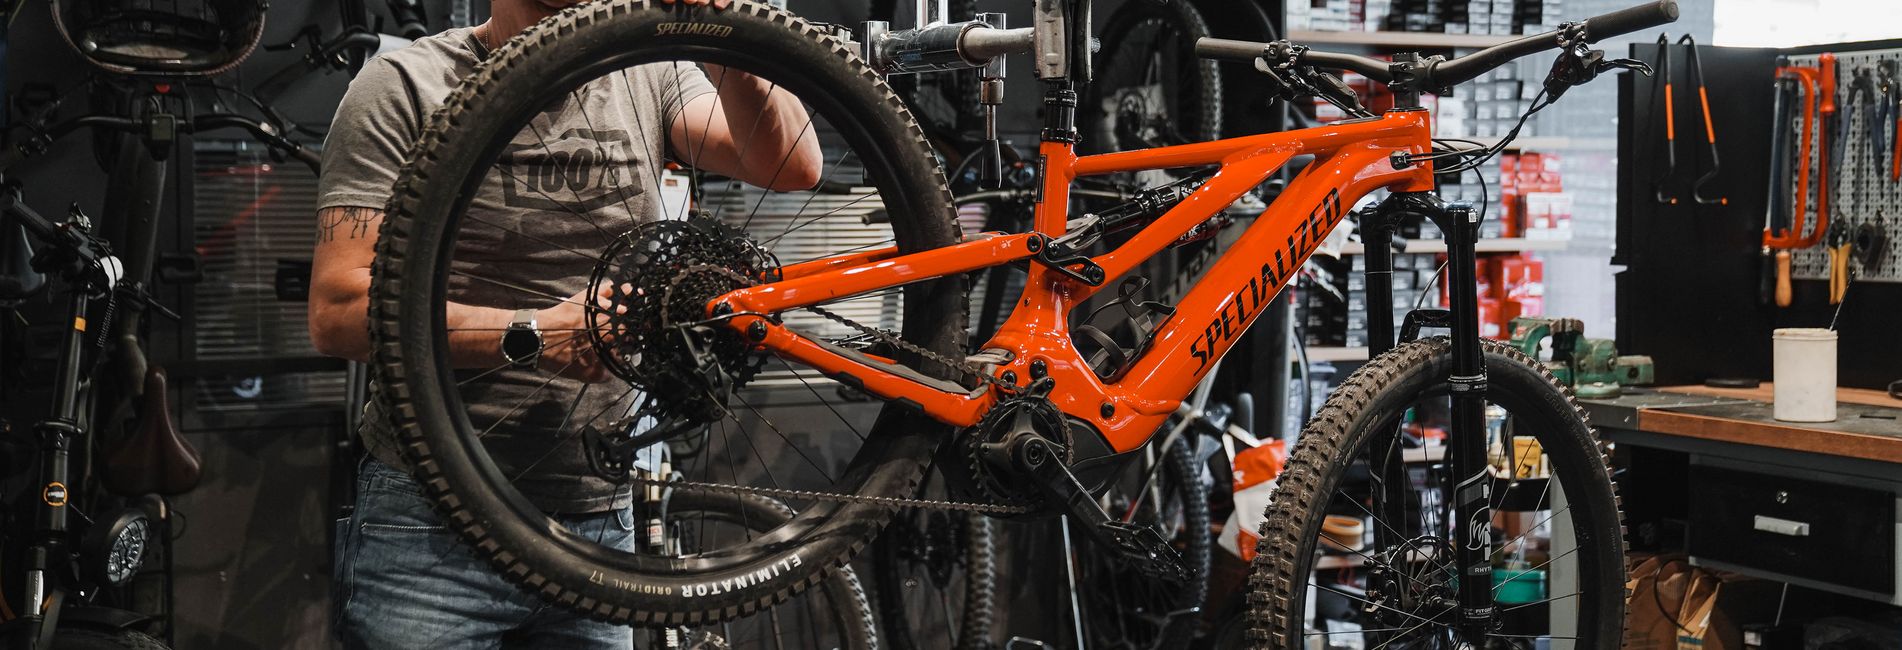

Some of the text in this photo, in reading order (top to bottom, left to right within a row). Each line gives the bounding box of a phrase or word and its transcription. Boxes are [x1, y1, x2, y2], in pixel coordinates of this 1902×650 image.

[655, 21, 734, 38] SPECIALIZED
[526, 146, 620, 193] 100%
[1190, 187, 1341, 376] SPECIALIZED
[590, 569, 606, 586] T7
[681, 554, 803, 598] ELIMINATOR
